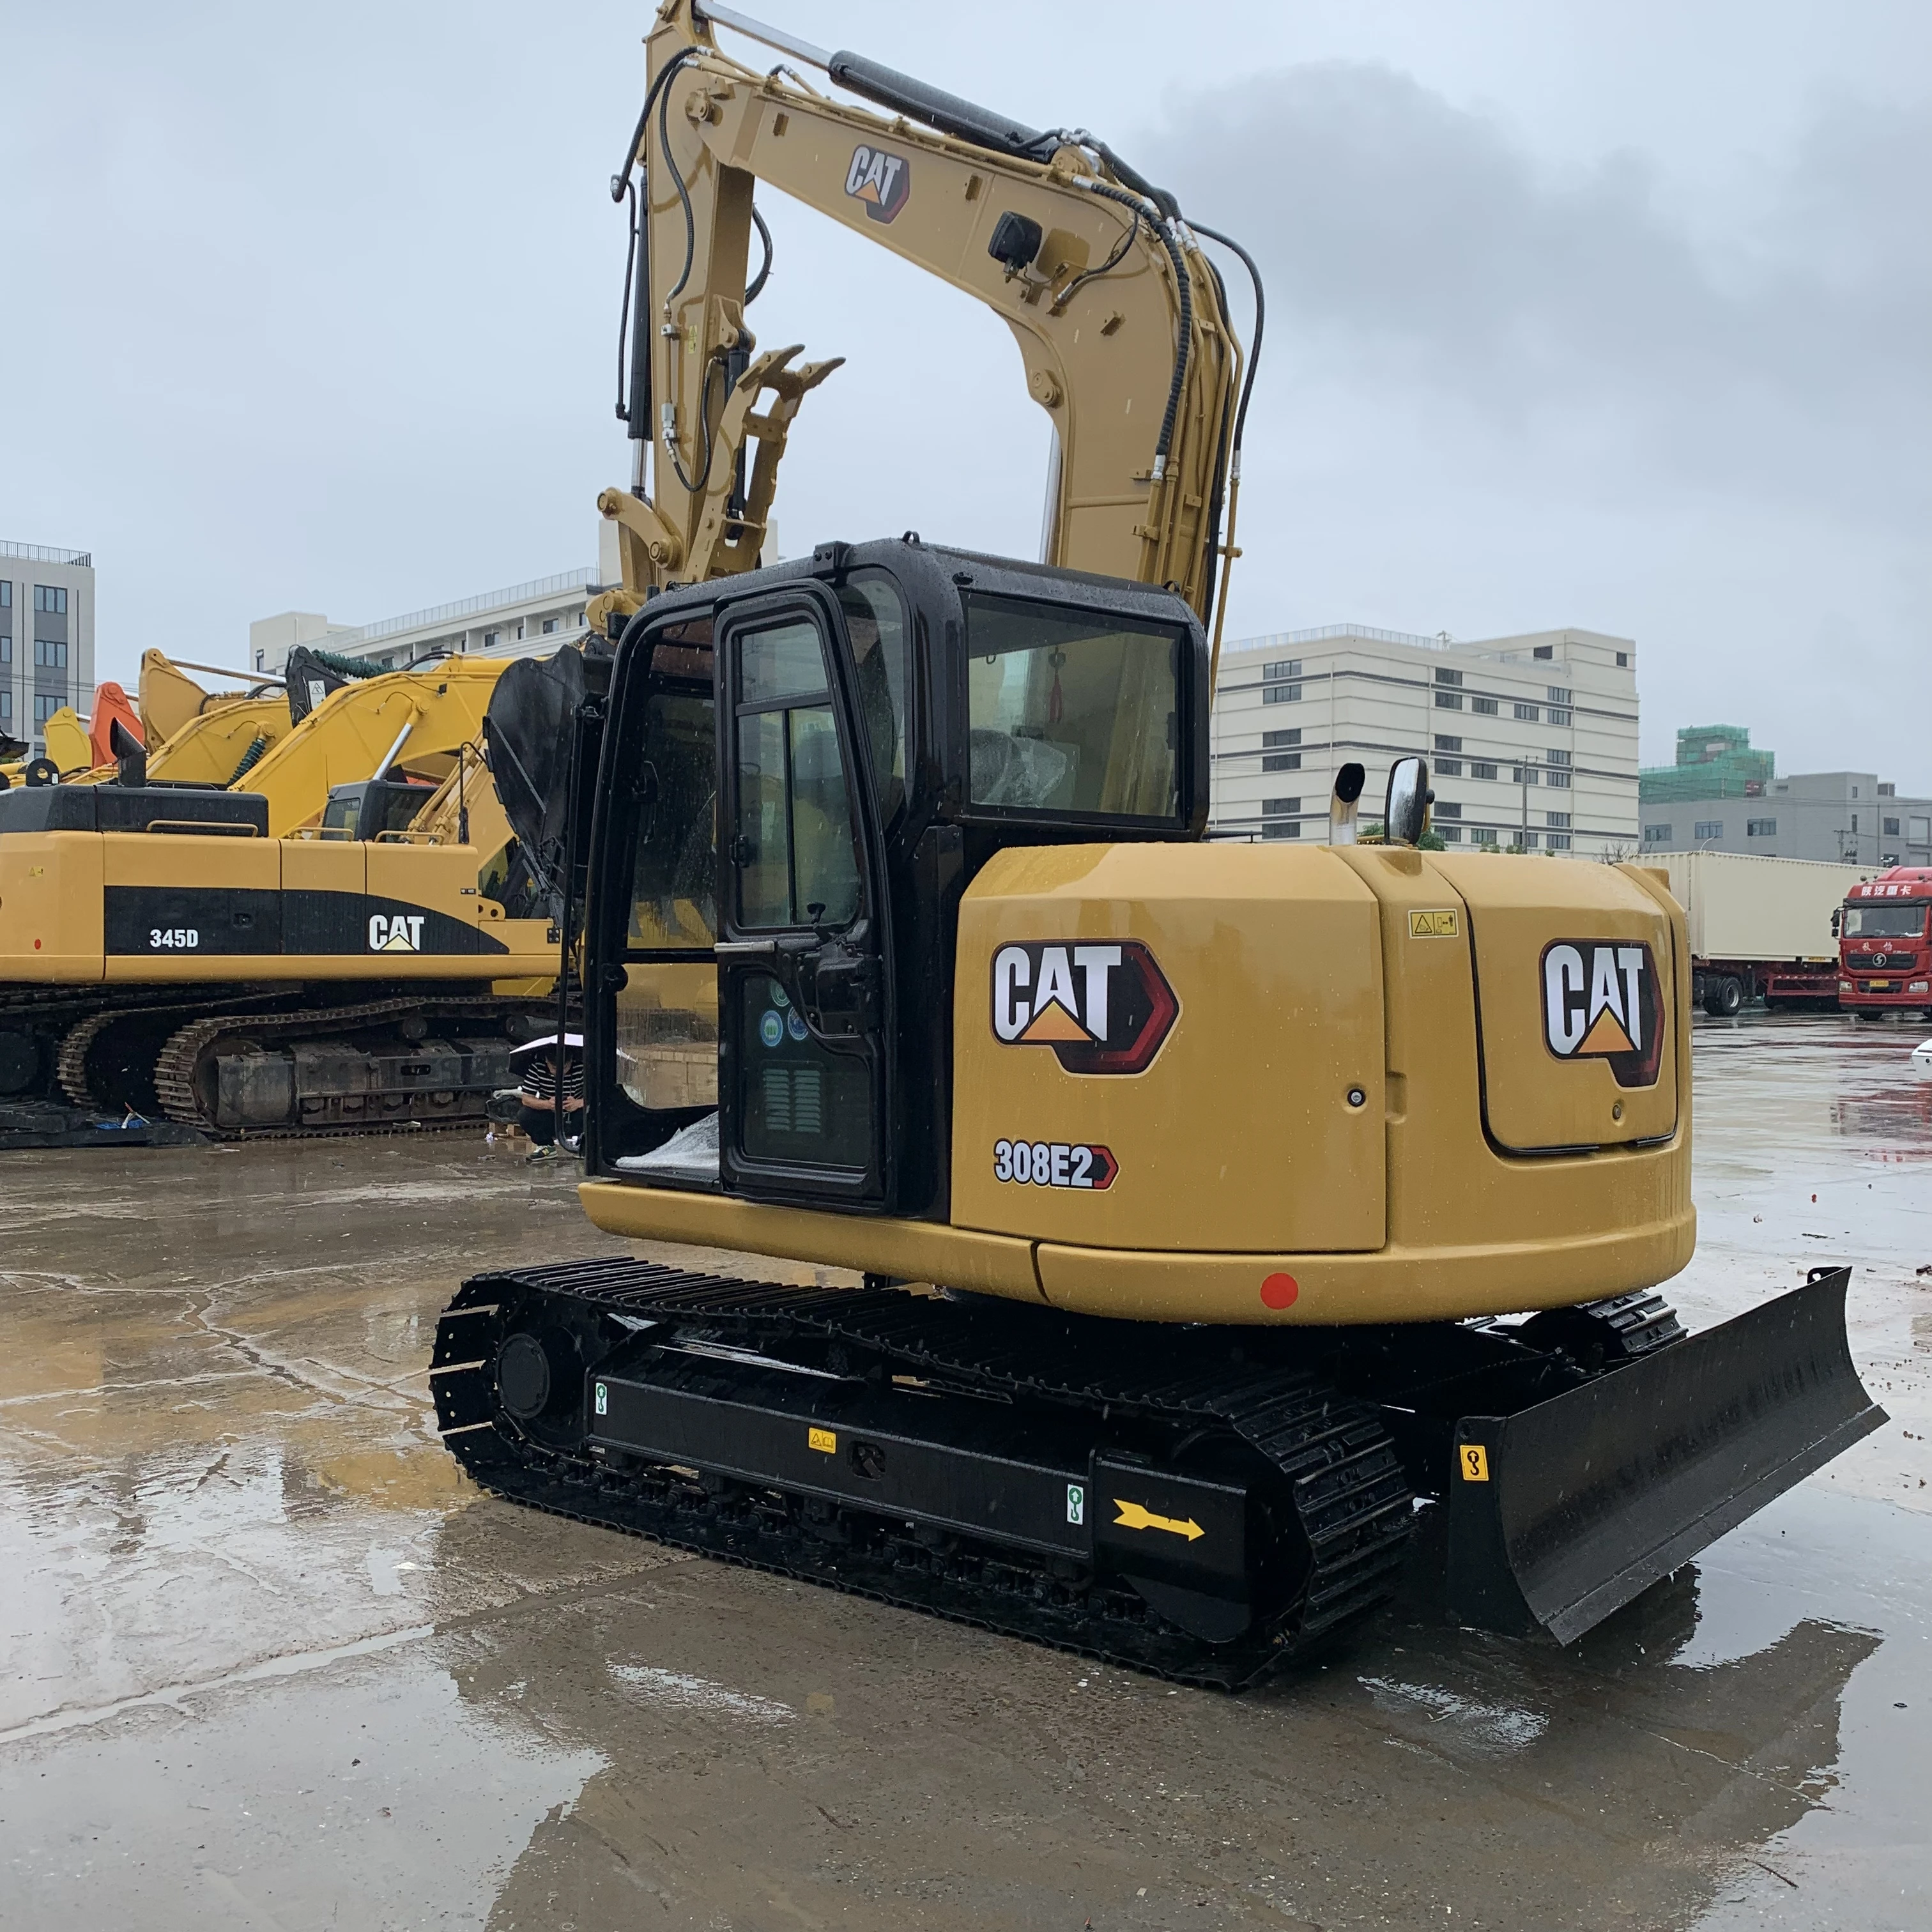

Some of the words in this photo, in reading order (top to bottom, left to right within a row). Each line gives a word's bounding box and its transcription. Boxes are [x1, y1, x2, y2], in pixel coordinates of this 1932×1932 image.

[845, 146, 902, 206] CAT
[150, 928, 199, 948] 345D
[369, 914, 425, 951] CAT
[995, 946, 1122, 1041] CAT
[1545, 944, 1644, 1055] CAT
[994, 1140, 1094, 1188] 308E2
